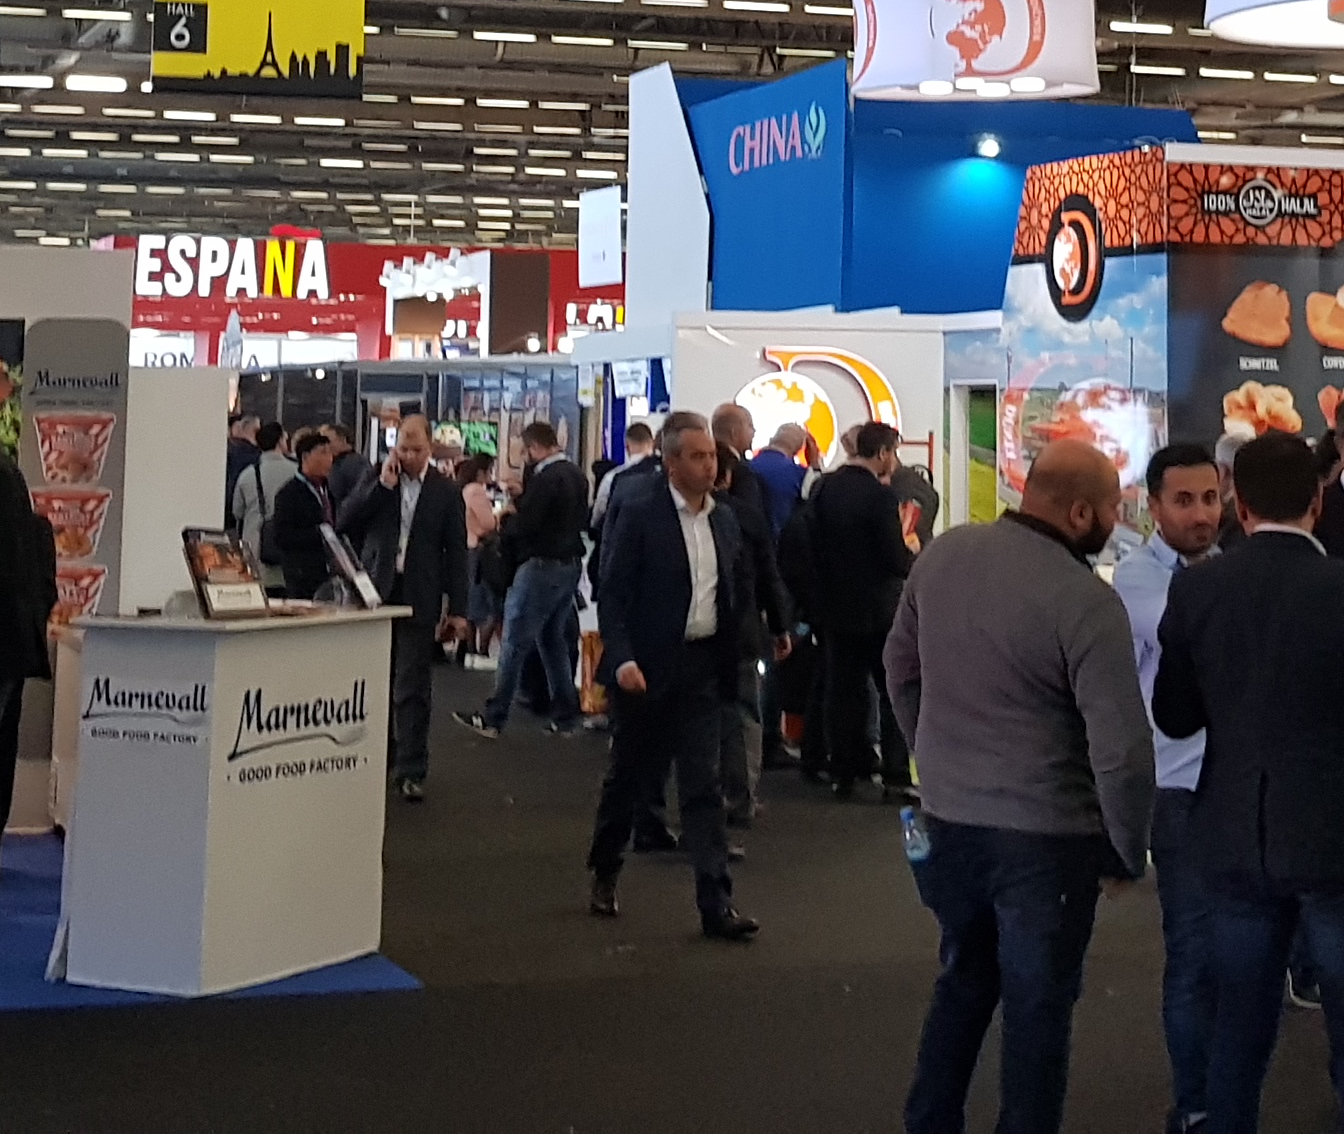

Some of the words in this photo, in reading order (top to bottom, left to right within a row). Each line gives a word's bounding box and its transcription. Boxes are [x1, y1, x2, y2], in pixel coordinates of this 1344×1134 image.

[167, 1, 196, 17] HALL
[169, 16, 191, 49] 6
[728, 109, 804, 176] CHINA
[1203, 193, 1236, 213] 100%
[1281, 196, 1318, 216] HALAL
[82, 676, 207, 720] Marnevall
[91, 726, 120, 740] GOOD
[122, 729, 151, 742] FOOD
[153, 731, 199, 745] FACTORY
[228, 678, 368, 763] Marnevall
[238, 765, 273, 783] GOOD
[275, 761, 307, 780] FOOD
[309, 755, 359, 775] FACTORY
